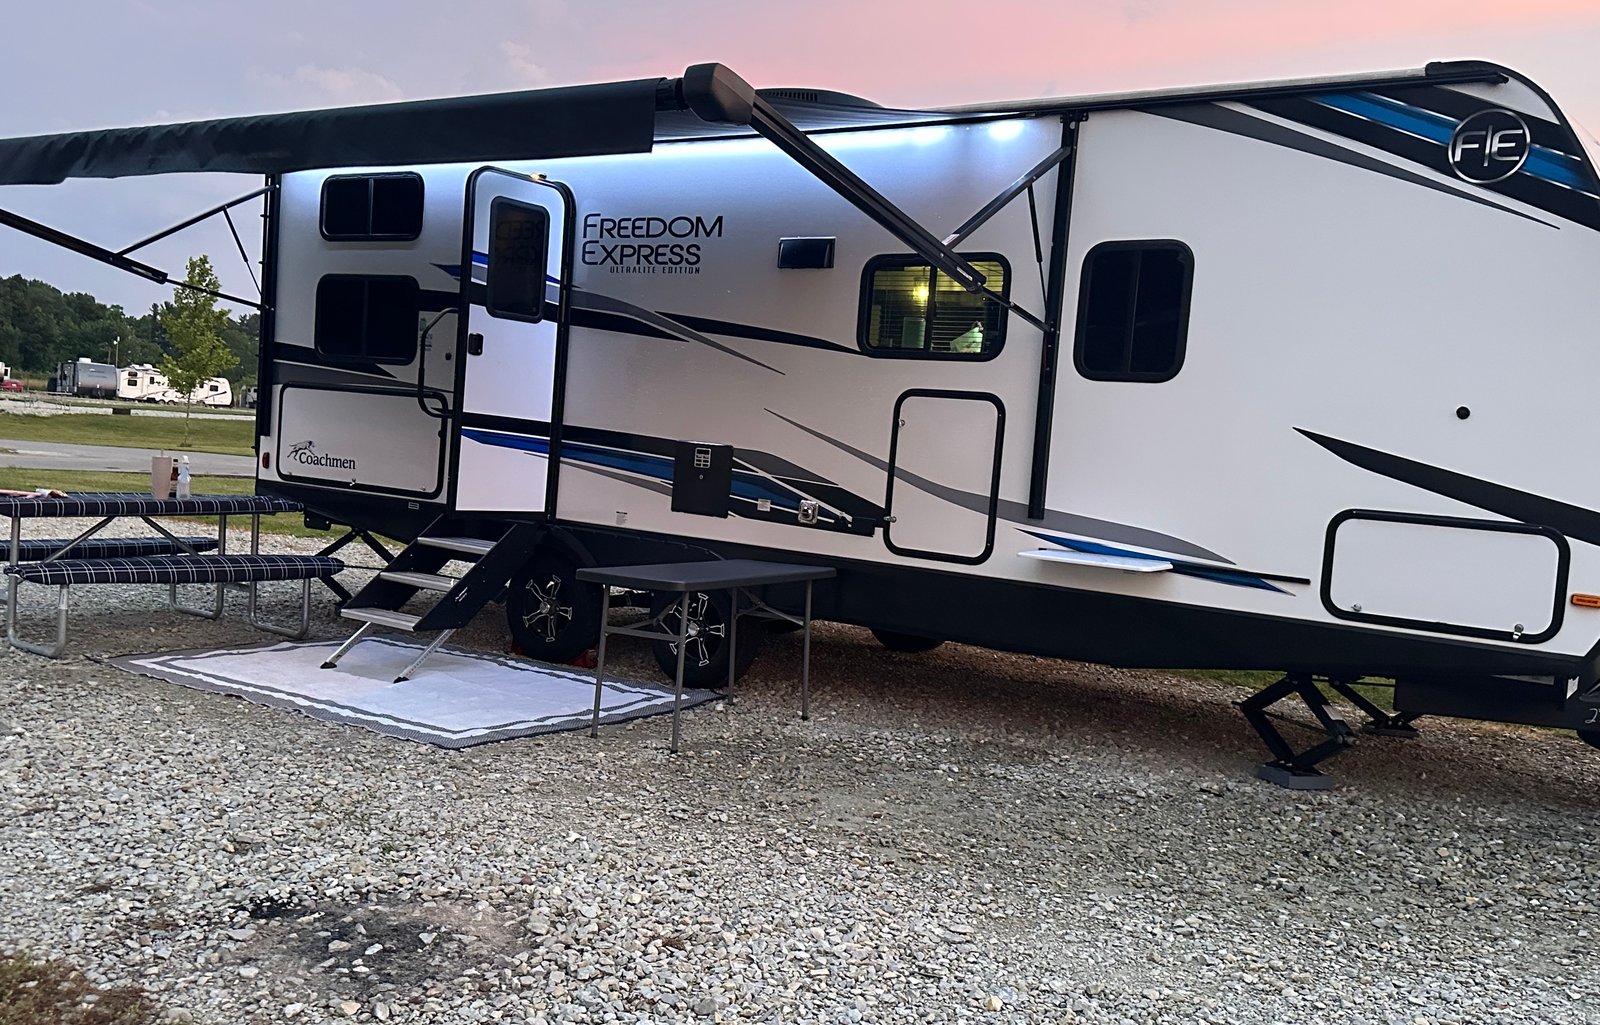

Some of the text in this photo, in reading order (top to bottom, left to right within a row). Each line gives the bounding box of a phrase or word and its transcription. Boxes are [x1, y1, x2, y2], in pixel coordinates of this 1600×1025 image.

[582, 212, 724, 239] FREEDOM
[581, 240, 702, 266] EXPRESS
[609, 266, 700, 275] ULTRALITE EDITION
[299, 451, 356, 470] Coachmen
